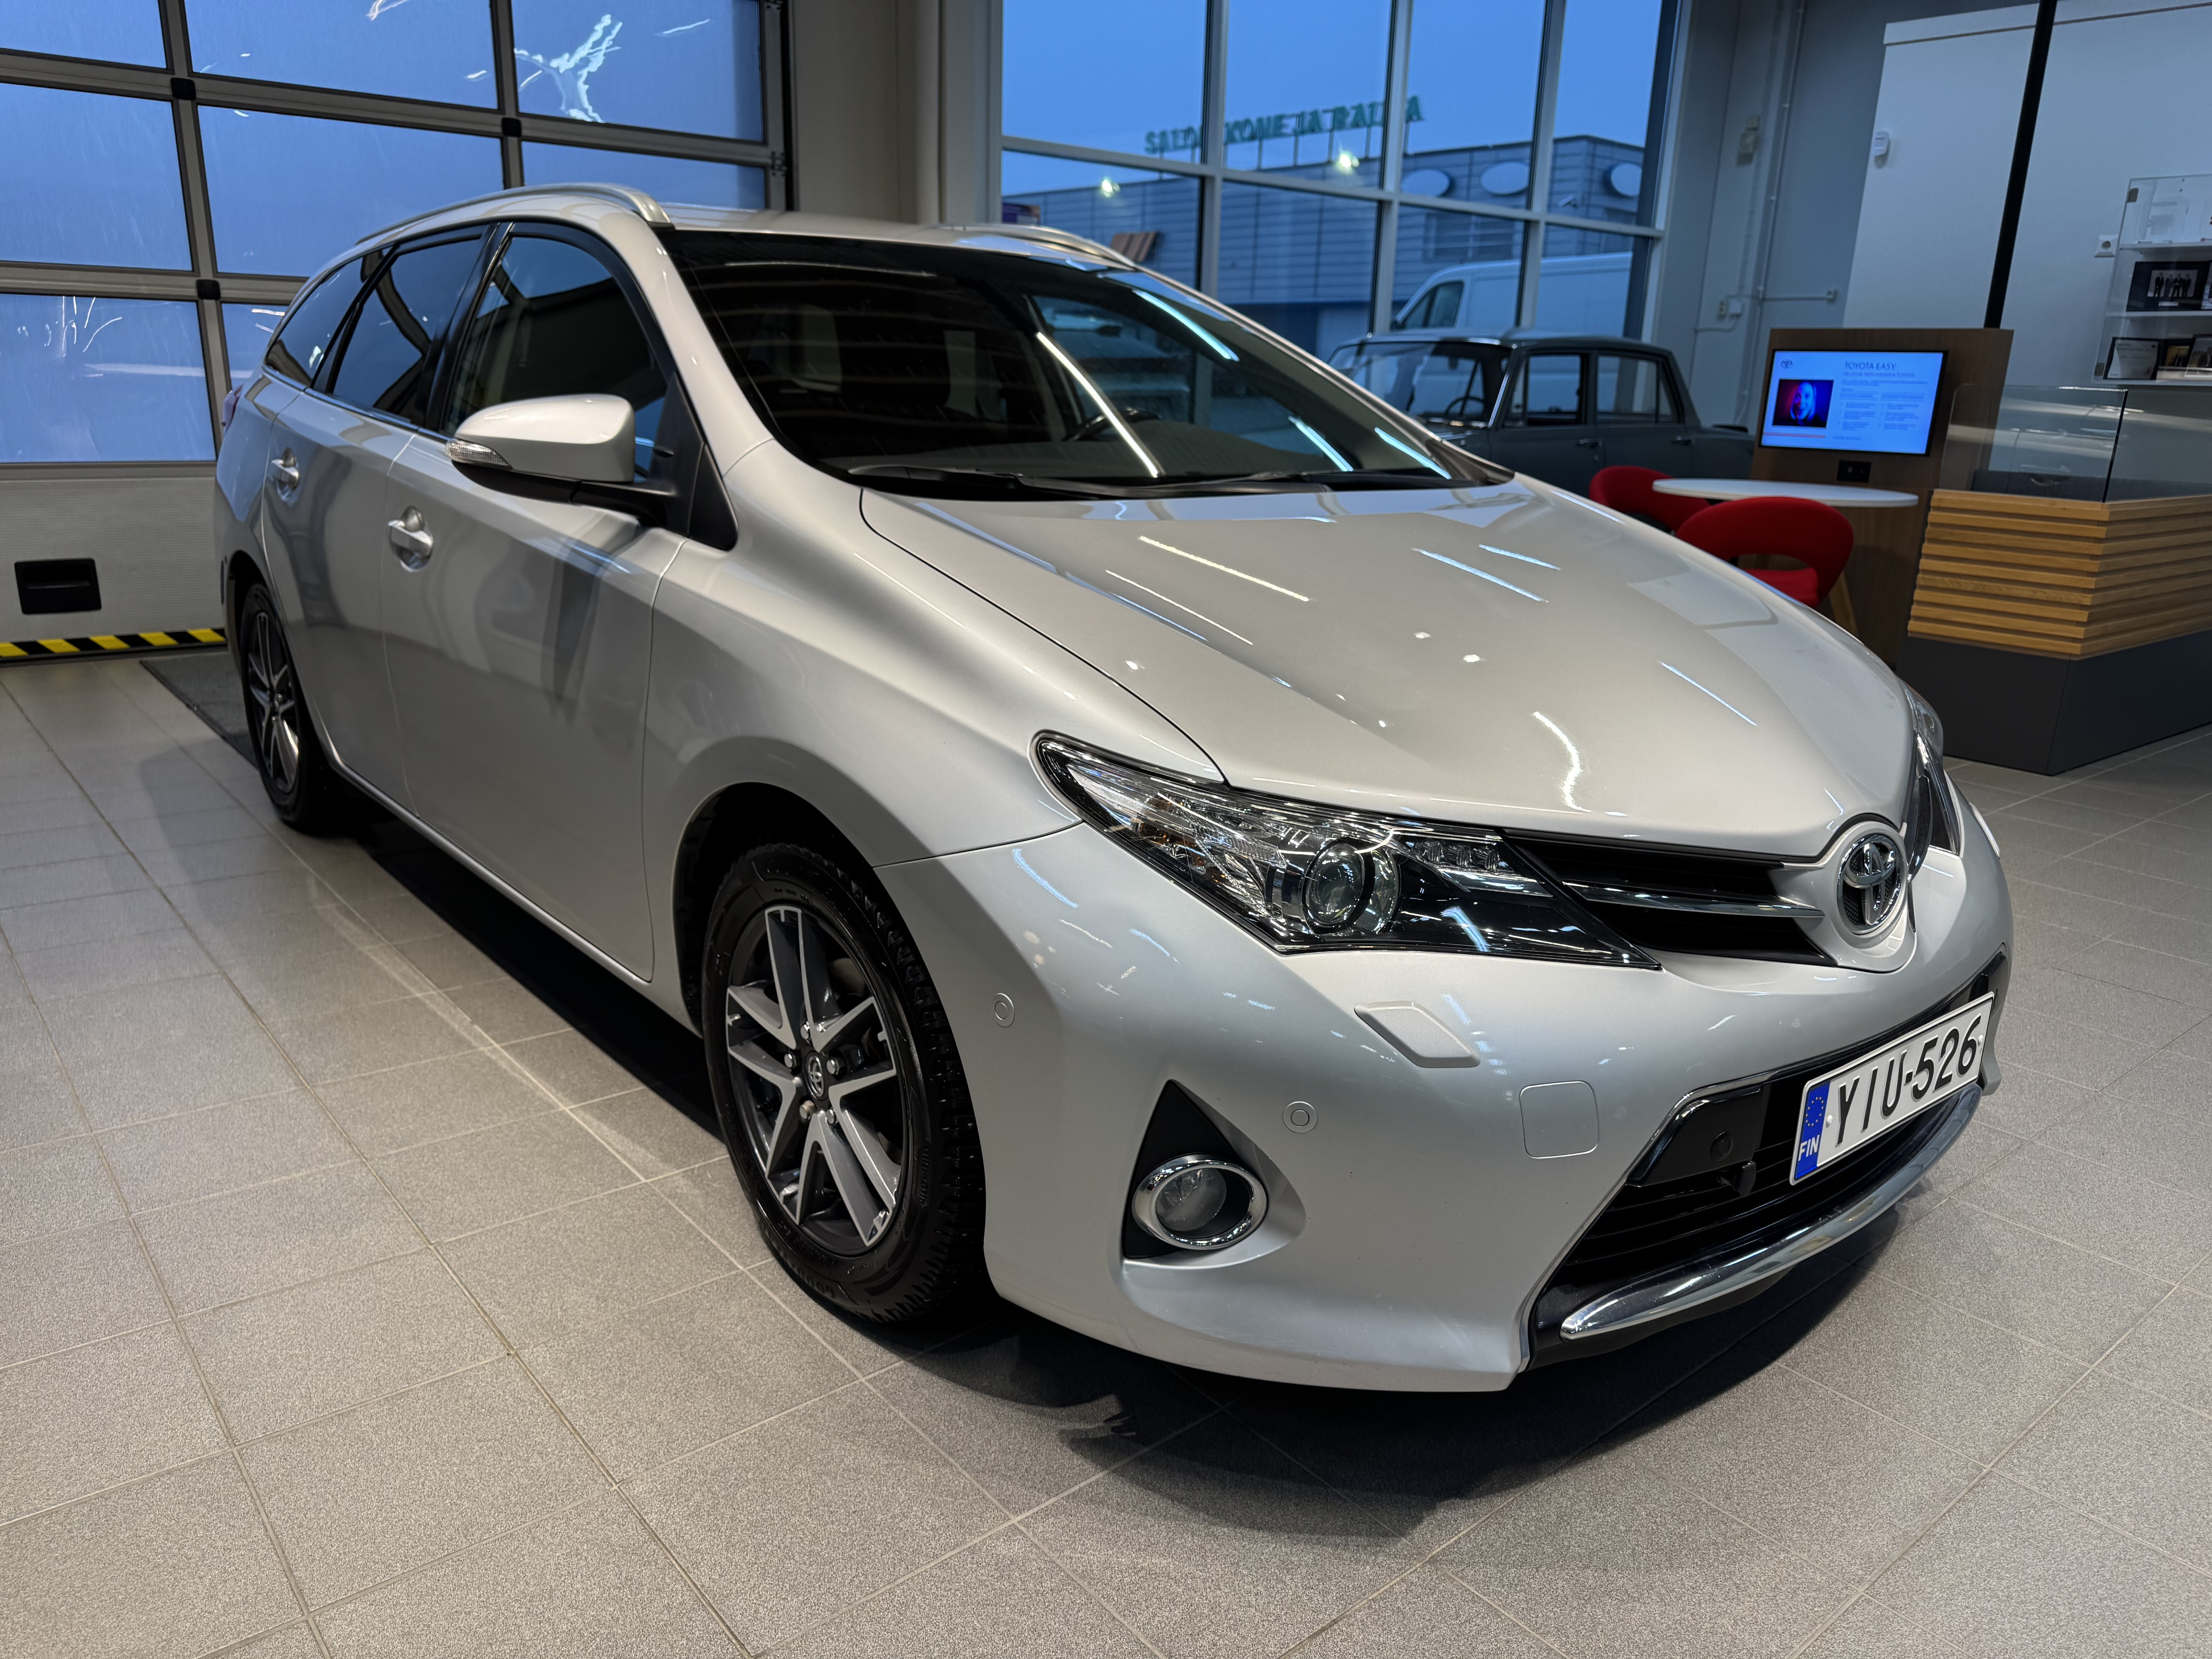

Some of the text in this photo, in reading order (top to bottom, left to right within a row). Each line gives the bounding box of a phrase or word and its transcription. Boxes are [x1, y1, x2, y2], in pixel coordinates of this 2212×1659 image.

[1145, 125, 1201, 154] SALO
[1333, 95, 1423, 131] RAUA
[1845, 361, 1896, 370] TOYOTA EASY
[1836, 1013, 1982, 1147] YIU-526
[1798, 1134, 1820, 1161] FIN
